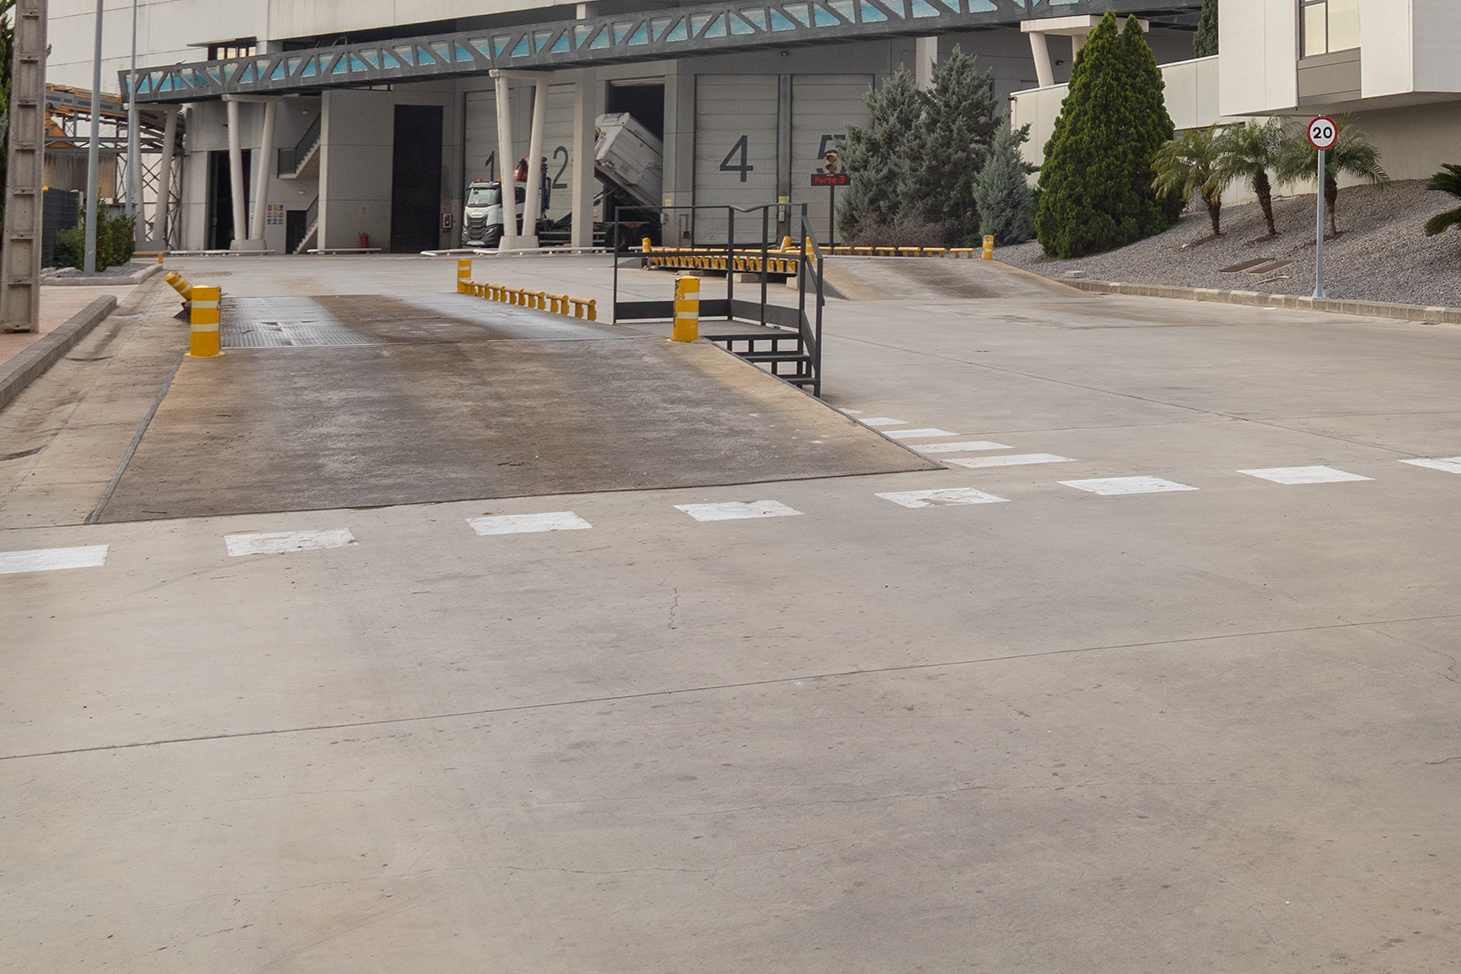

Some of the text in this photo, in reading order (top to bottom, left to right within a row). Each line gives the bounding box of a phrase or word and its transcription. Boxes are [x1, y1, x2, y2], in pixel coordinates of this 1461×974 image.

[1313, 126, 1333, 139] 20
[552, 145, 569, 189] 2
[719, 135, 754, 182] 4
[814, 175, 845, 184] Porta 3
